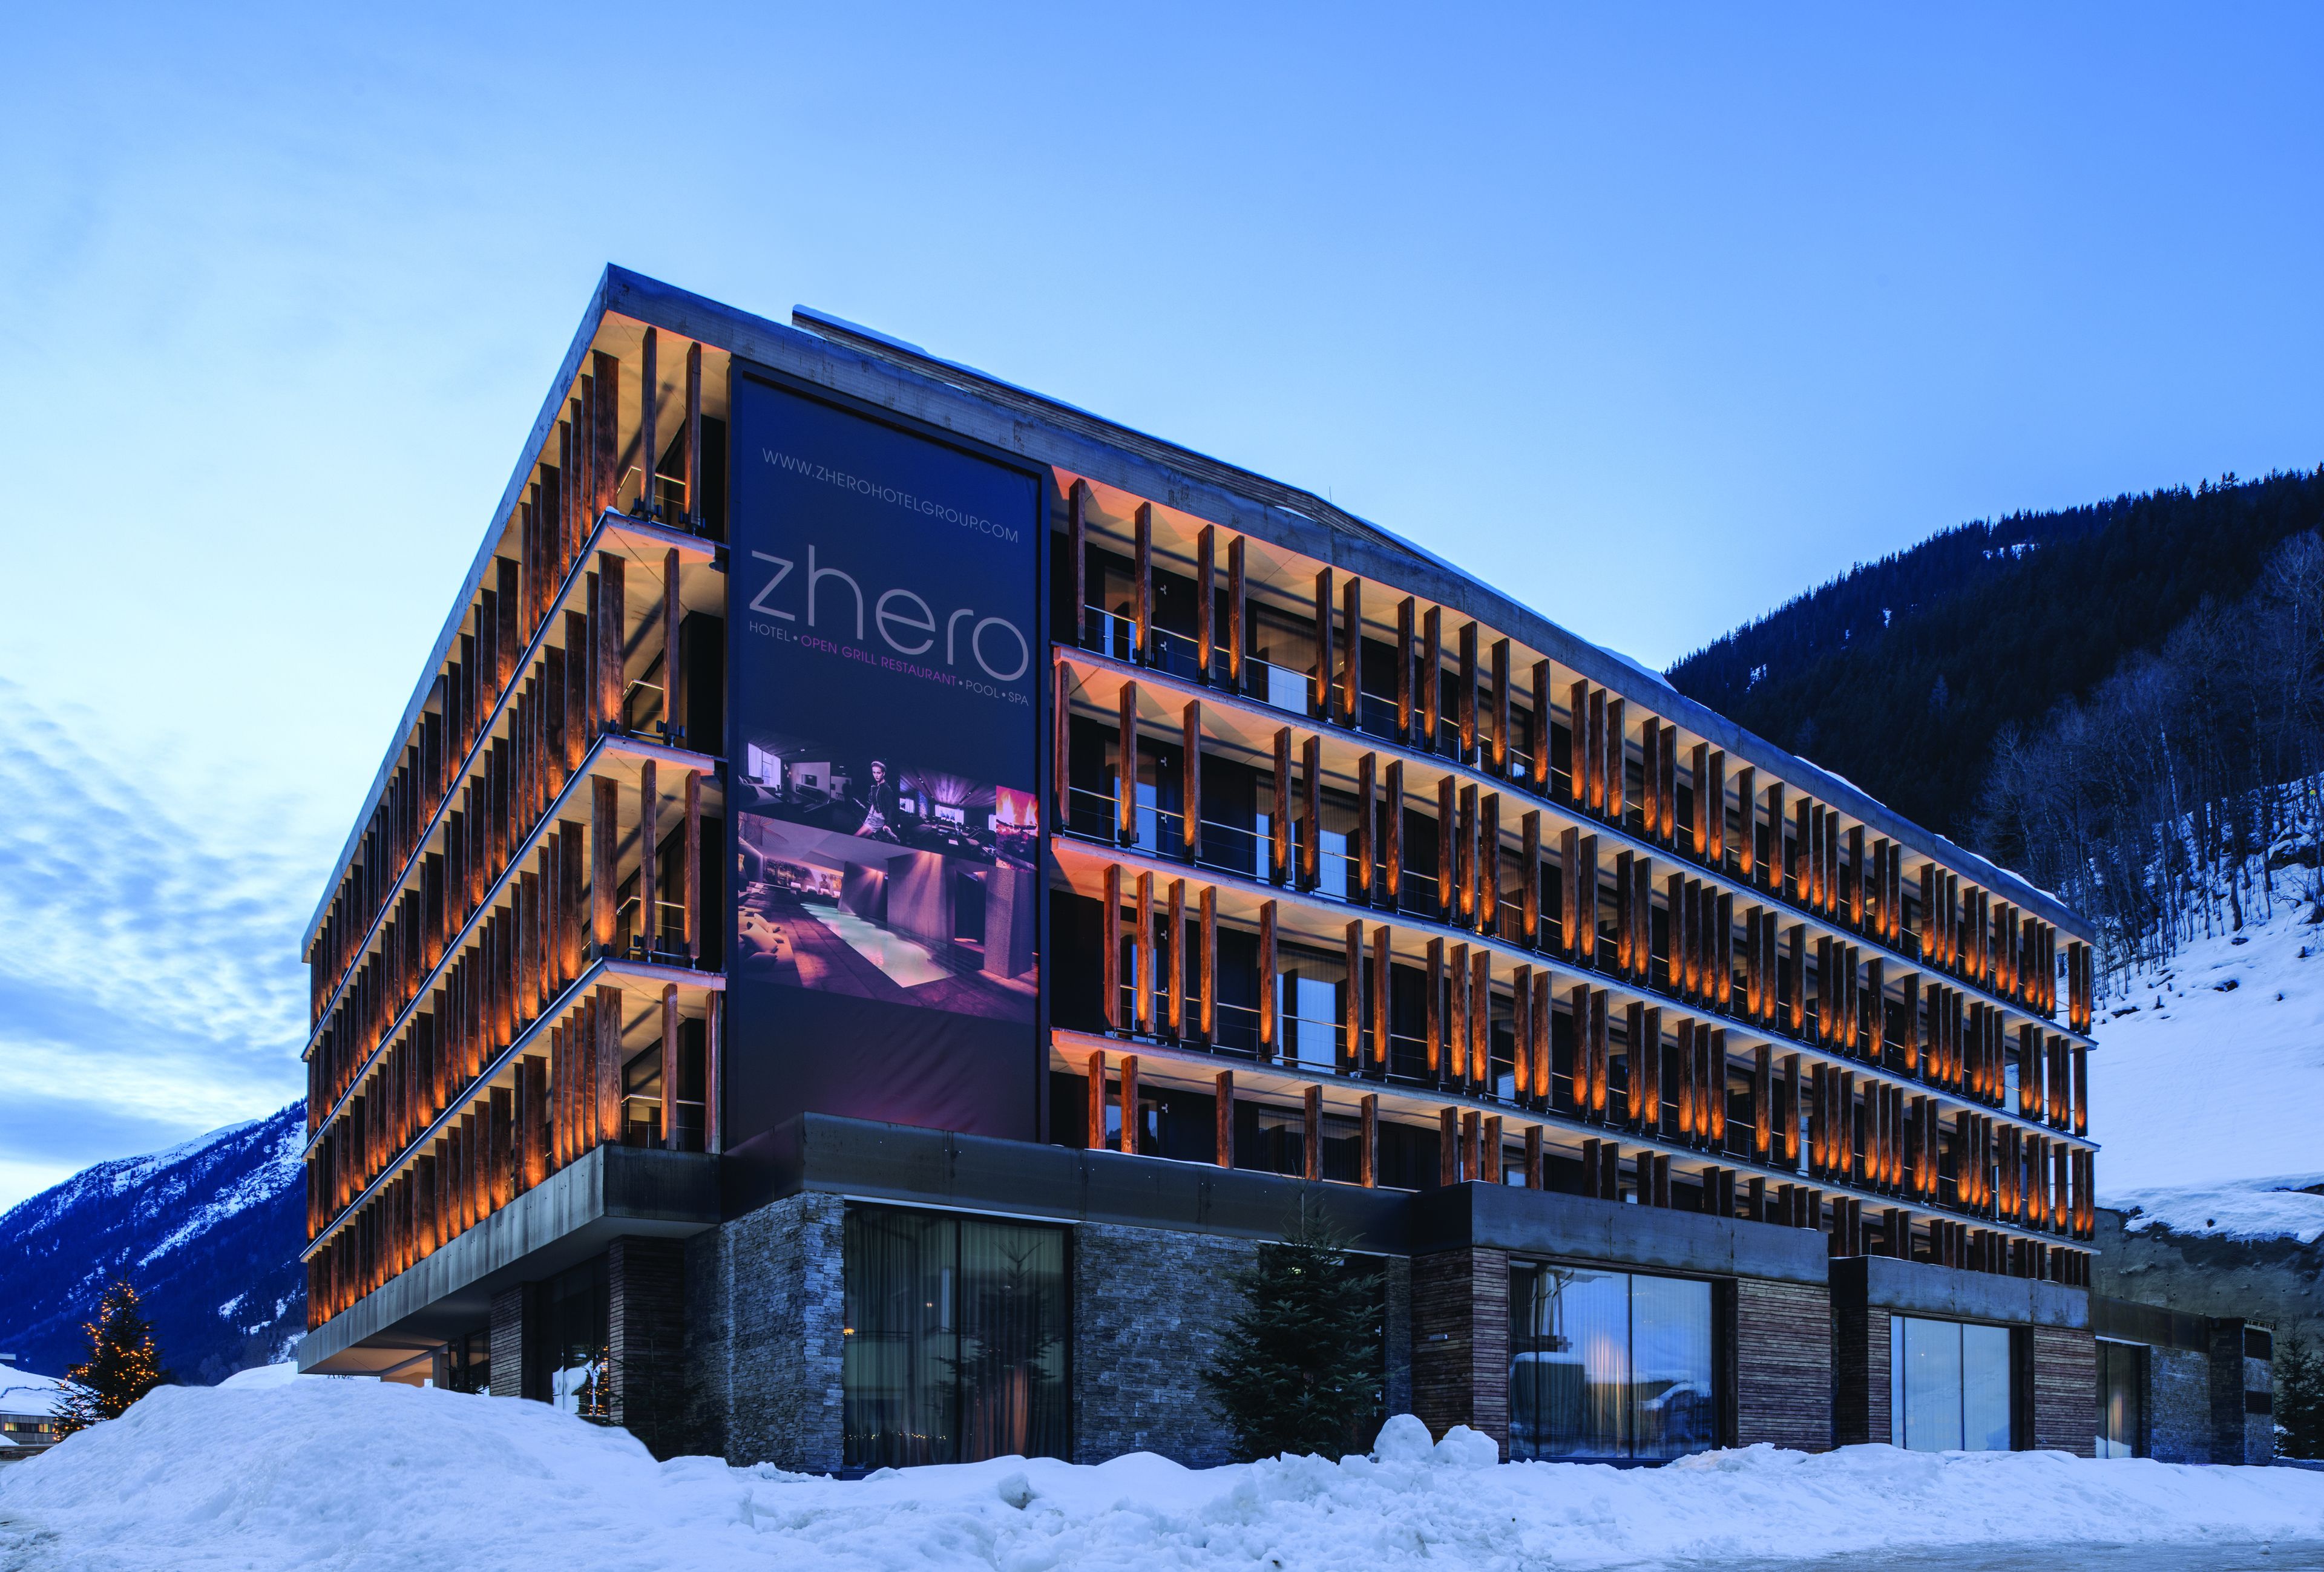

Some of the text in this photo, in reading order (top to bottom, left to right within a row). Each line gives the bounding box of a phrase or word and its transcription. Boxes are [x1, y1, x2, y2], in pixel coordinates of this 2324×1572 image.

[762, 447, 1018, 543] WWW.ZHEROHOTELGROUP.COM
[749, 544, 1029, 681] zhero
[749, 621, 1029, 707] HOTEL OPEN GRILL RESTAURANT POOL SPA
